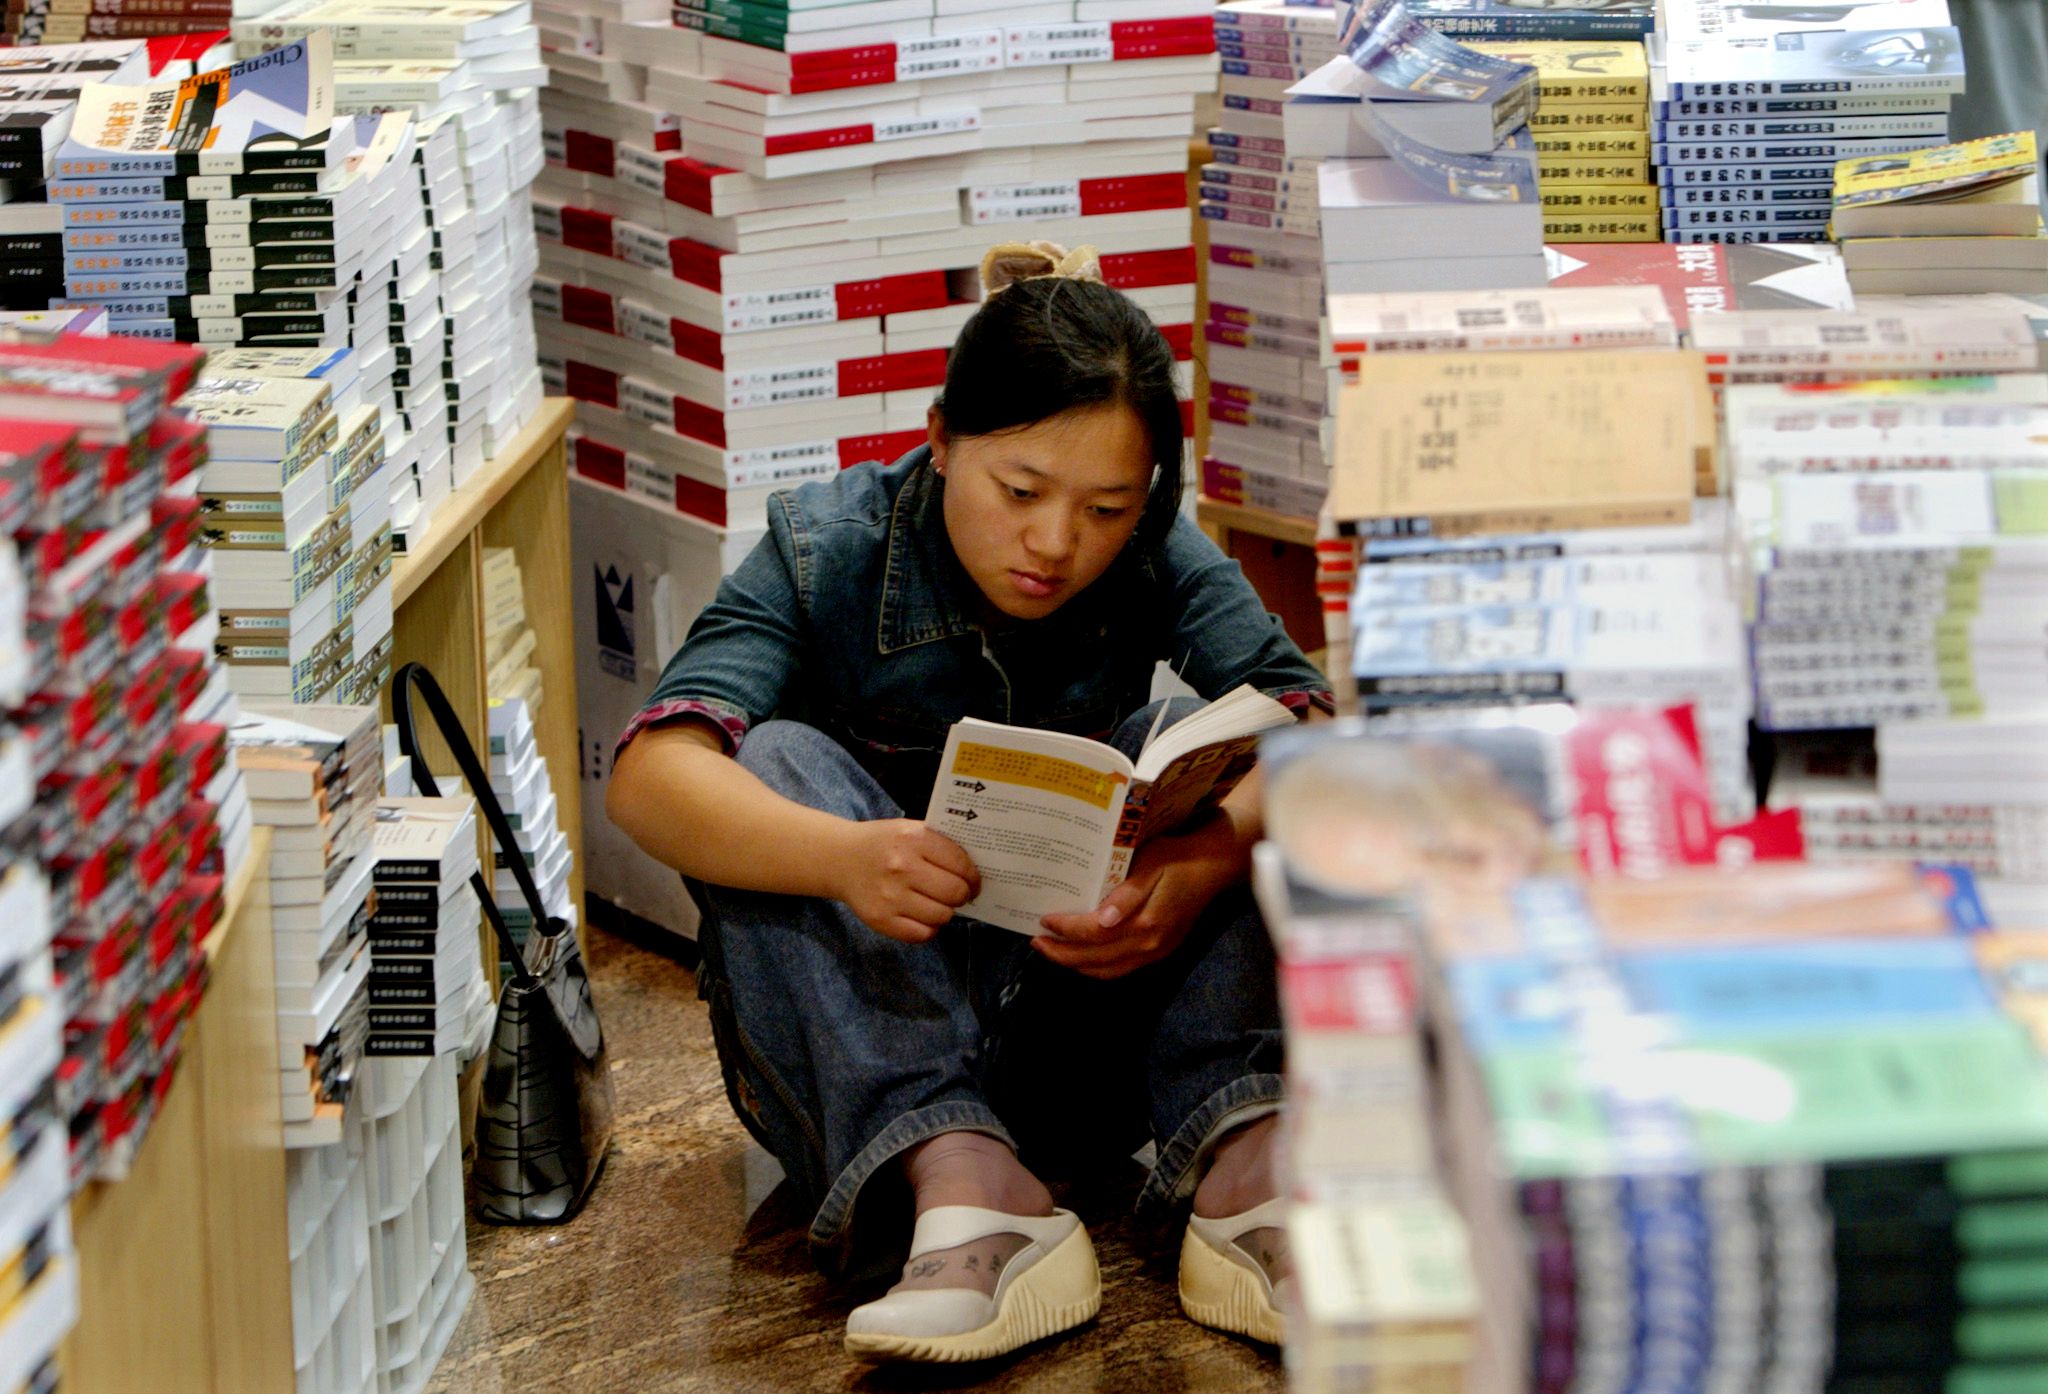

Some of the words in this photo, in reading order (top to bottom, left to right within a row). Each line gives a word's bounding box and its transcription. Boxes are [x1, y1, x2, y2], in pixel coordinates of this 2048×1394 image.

[180, 44, 302, 90] Chenggong
[1577, 84, 1638, 97] 今世商人宝典
[1695, 83, 1772, 94] 性格的力量
[1681, 100, 1758, 113] 性格的力量
[129, 88, 178, 152] 说话办事绝招
[1575, 112, 1635, 125] 今世商人宝典
[1679, 123, 1755, 135] 性格的力量
[1575, 140, 1636, 153] 今世商人宝典
[1680, 146, 1757, 158] 性格的力量
[1576, 165, 1636, 179] 今世商人宝典
[1685, 169, 1762, 181] 性格的力量
[1588, 194, 1647, 206] 今世商人宝典
[1687, 189, 1764, 202] 性格的力量
[1690, 210, 1767, 222] 性格的力量
[1588, 222, 1648, 235] 今世商人宝典
